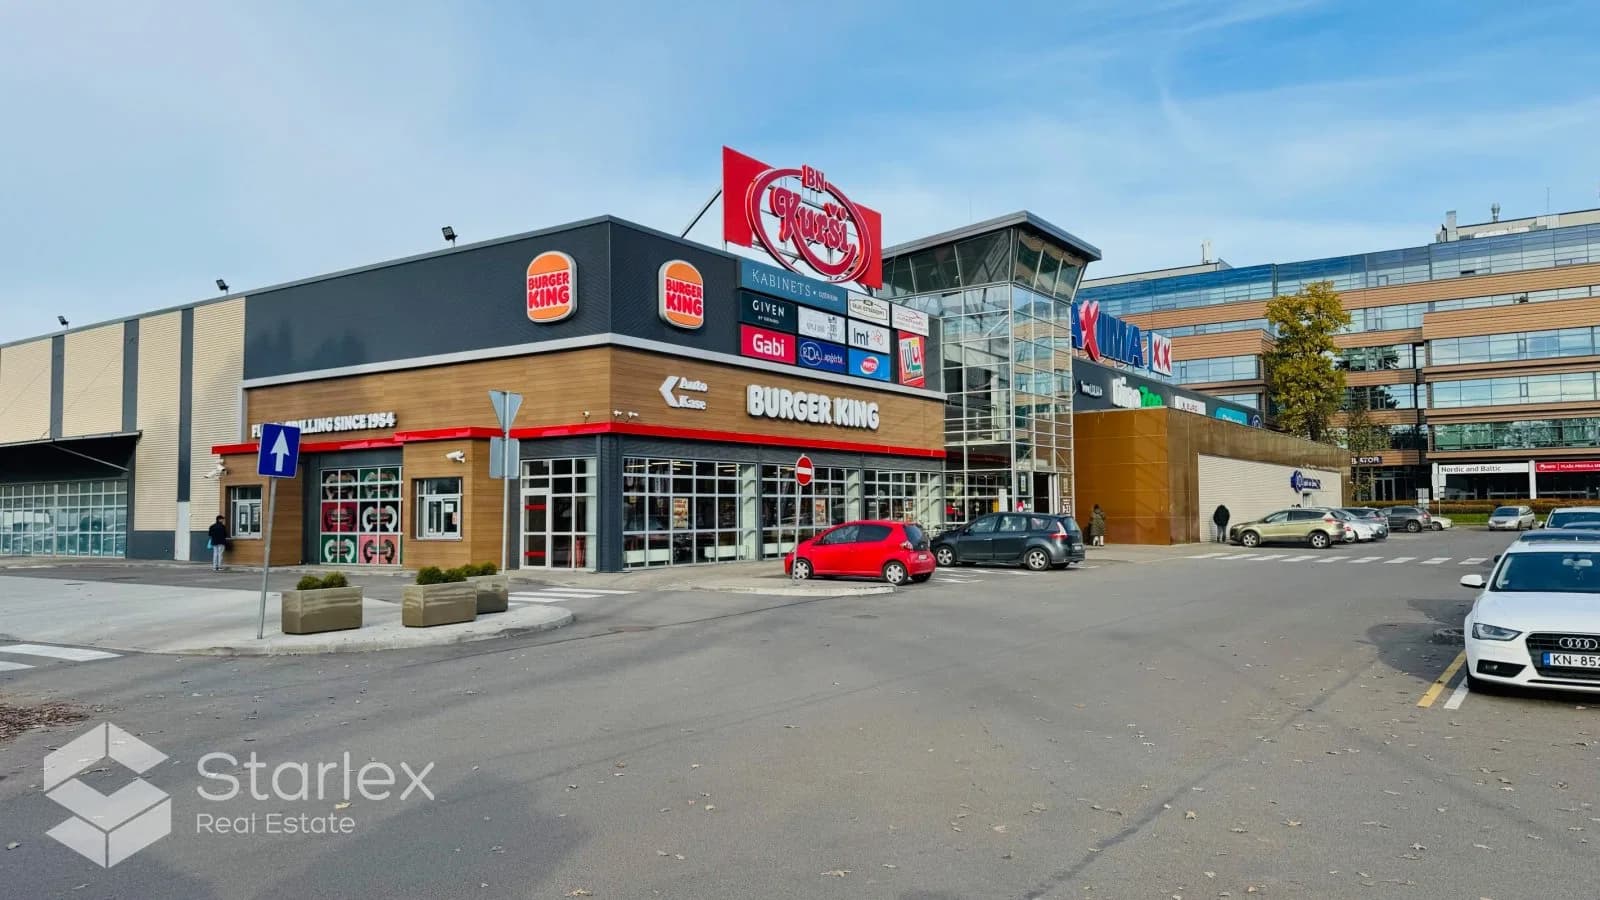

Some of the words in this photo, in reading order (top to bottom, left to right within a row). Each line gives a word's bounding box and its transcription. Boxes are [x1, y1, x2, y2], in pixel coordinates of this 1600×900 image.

[802, 165, 825, 192] BN
[769, 187, 853, 258] Kurši
[528, 272, 569, 290] BURGER
[665, 279, 702, 299] BURGER
[752, 269, 811, 297] KABINETS
[528, 285, 569, 309] KING
[665, 293, 702, 316] KING
[752, 299, 785, 317] GIVEN
[752, 333, 785, 357] Gabi
[1071, 300, 1144, 371] AXIMA
[679, 376, 708, 391] Auto
[679, 395, 706, 410] Kase
[747, 384, 832, 424] BURGER
[833, 397, 880, 430] KING
[334, 412, 367, 431] SINCE
[368, 411, 395, 429] 1954
[1553, 654, 1600, 667] KN-85
